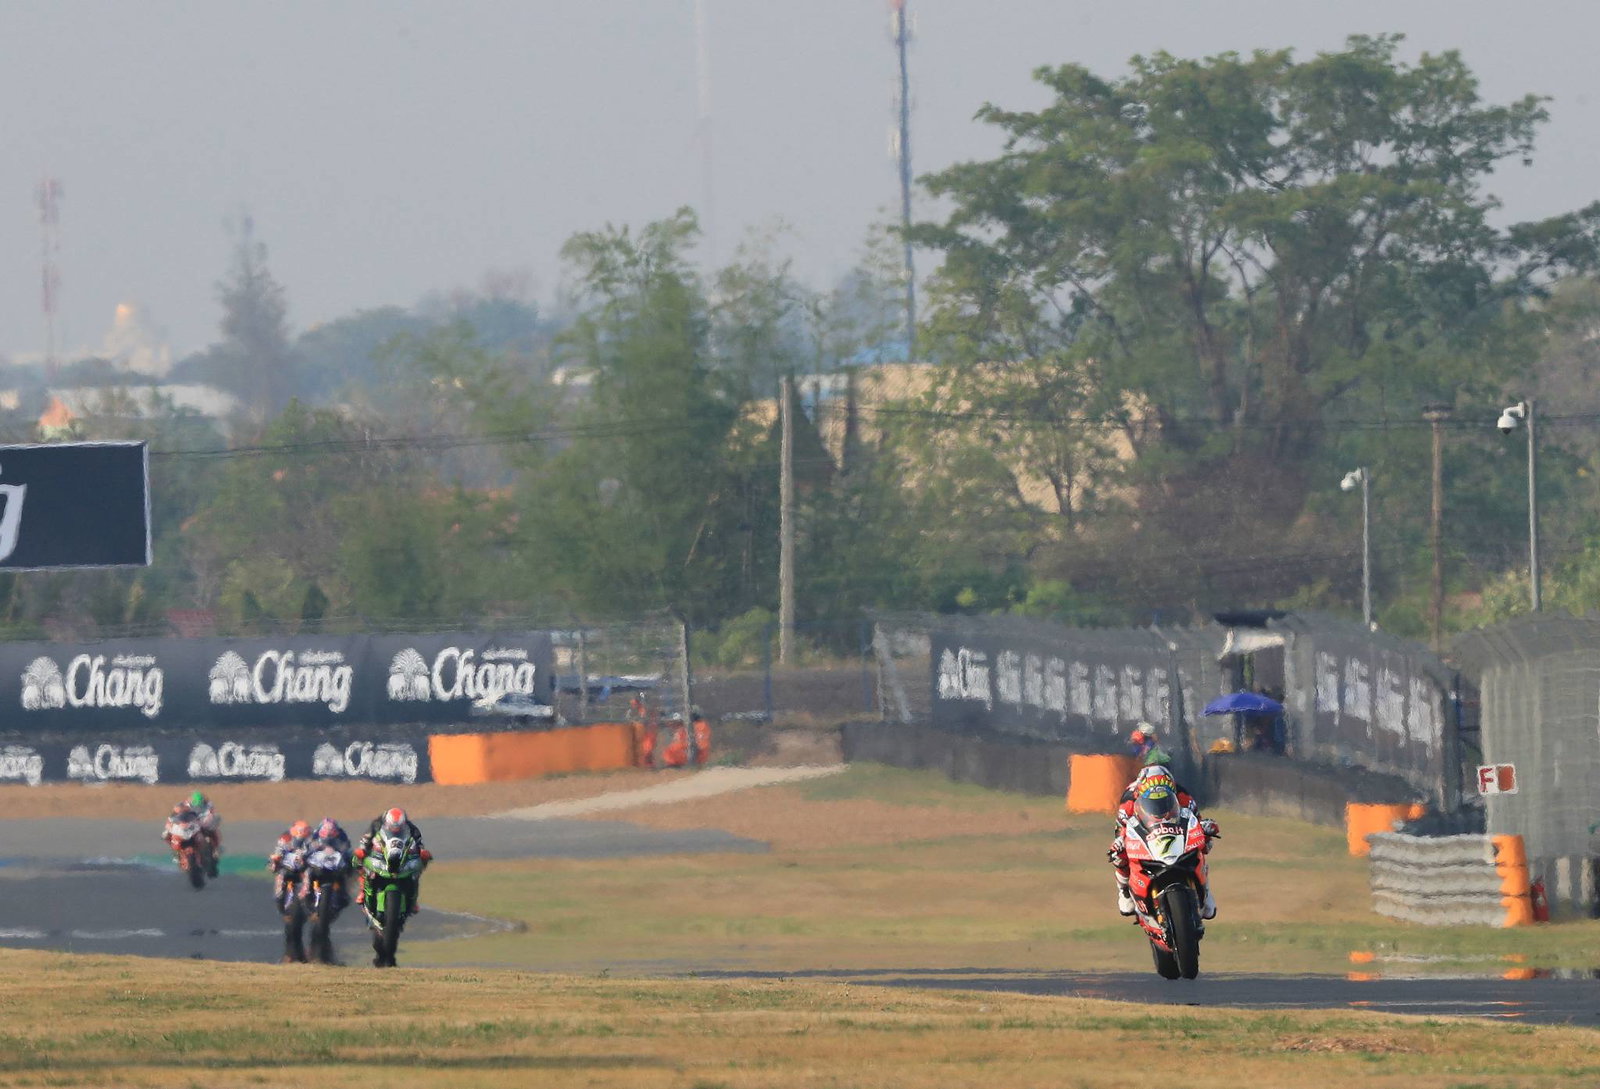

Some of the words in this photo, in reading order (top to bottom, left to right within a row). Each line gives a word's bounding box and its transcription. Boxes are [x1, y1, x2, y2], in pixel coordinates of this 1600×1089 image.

[66, 653, 163, 717] Chang
[253, 650, 353, 713] Chang
[1479, 767, 1494, 792] F
[1160, 835, 1176, 855] 7
